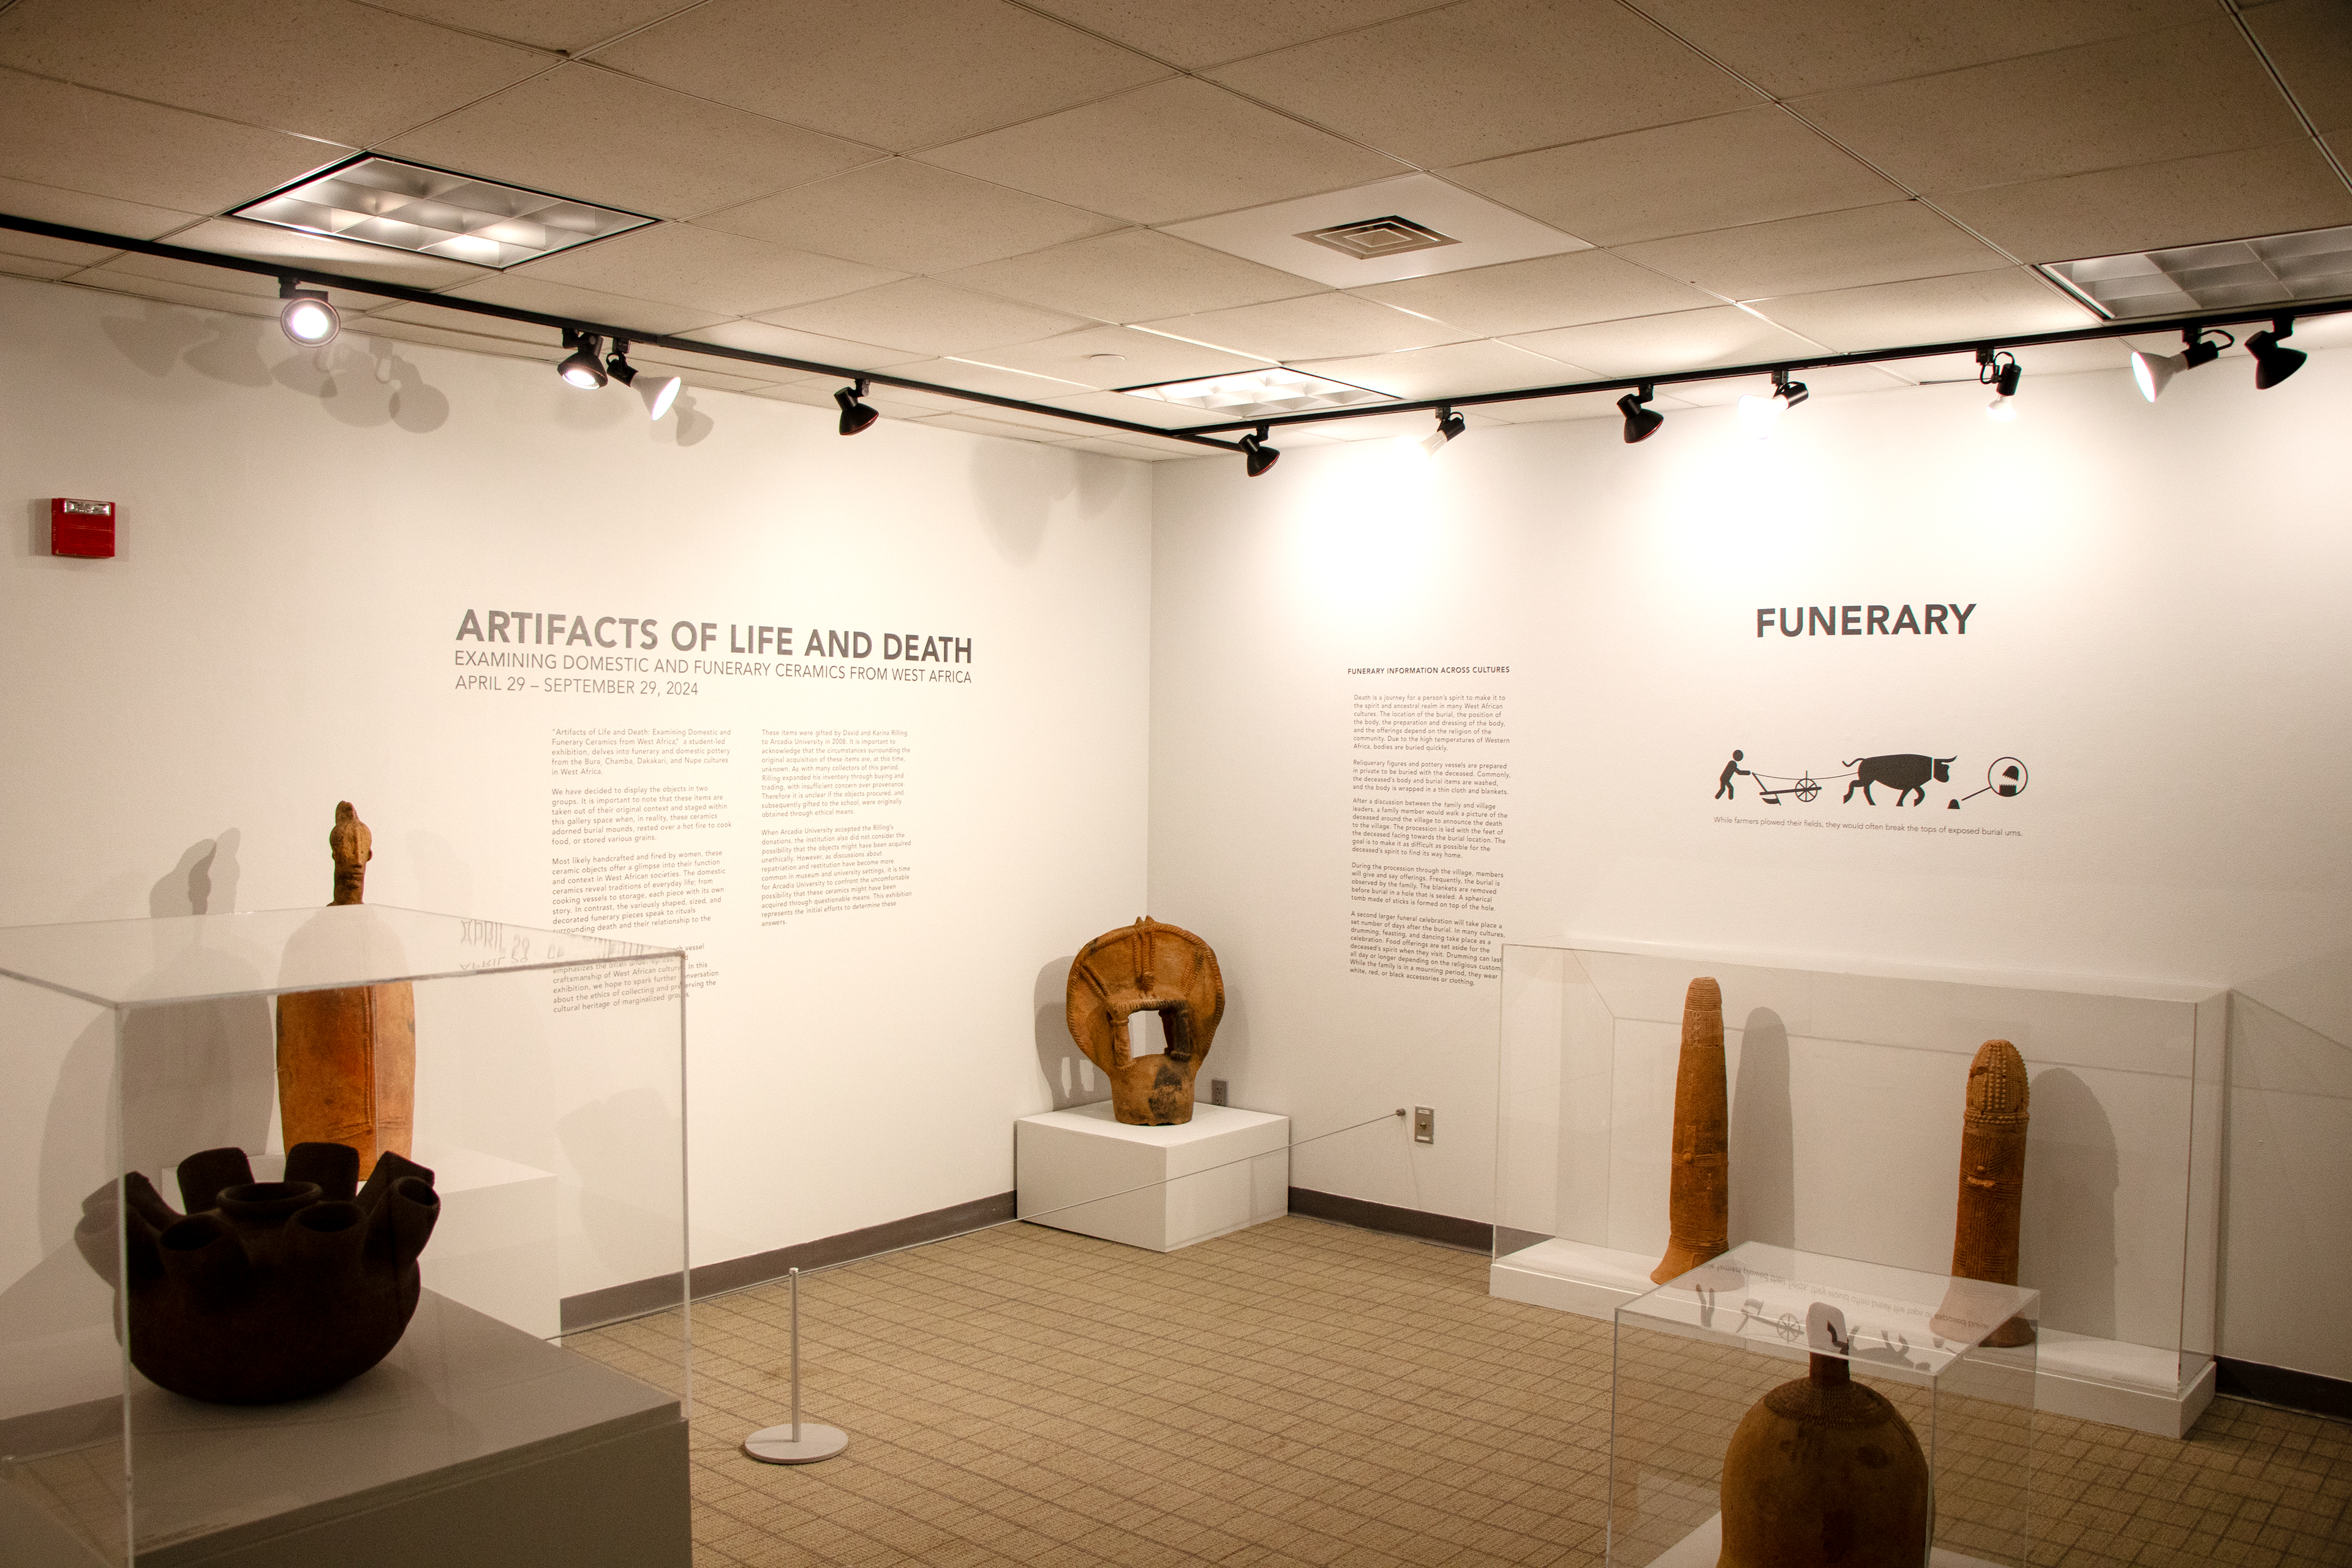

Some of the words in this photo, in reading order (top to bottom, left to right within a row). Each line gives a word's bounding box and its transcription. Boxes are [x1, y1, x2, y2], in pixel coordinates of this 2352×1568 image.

[1757, 603, 1976, 637] FUNERARY
[456, 609, 657, 650] ARTIFACTS
[671, 621, 716, 652] OF
[731, 624, 792, 656] LIFE
[804, 628, 872, 659] AND
[884, 632, 971, 663] DEATH
[455, 651, 556, 669] EXAMINING
[564, 655, 648, 672] DOMESTIC
[654, 658, 688, 674] AND
[695, 660, 771, 676] FUNERARY
[775, 662, 845, 679] CERAMICS
[850, 665, 887, 680] FROM
[892, 666, 925, 681] WEST
[929, 668, 971, 683] AFRICA
[455, 674, 501, 690] APRIL
[507, 676, 525, 691] 29
[545, 676, 634, 694] SEPTEMBER
[640, 679, 660, 696] 29,
[666, 679, 698, 695] 2024
[652, 728, 685, 737] Examining
[552, 739, 582, 747] Funerary
[631, 748, 659, 756] funerary
[684, 757, 701, 766] Nupe
[761, 910, 793, 919] represents
[1449, 978, 1474, 987] clothing.
[553, 1003, 579, 1012] cultural
[622, 993, 664, 1005] marginalized
